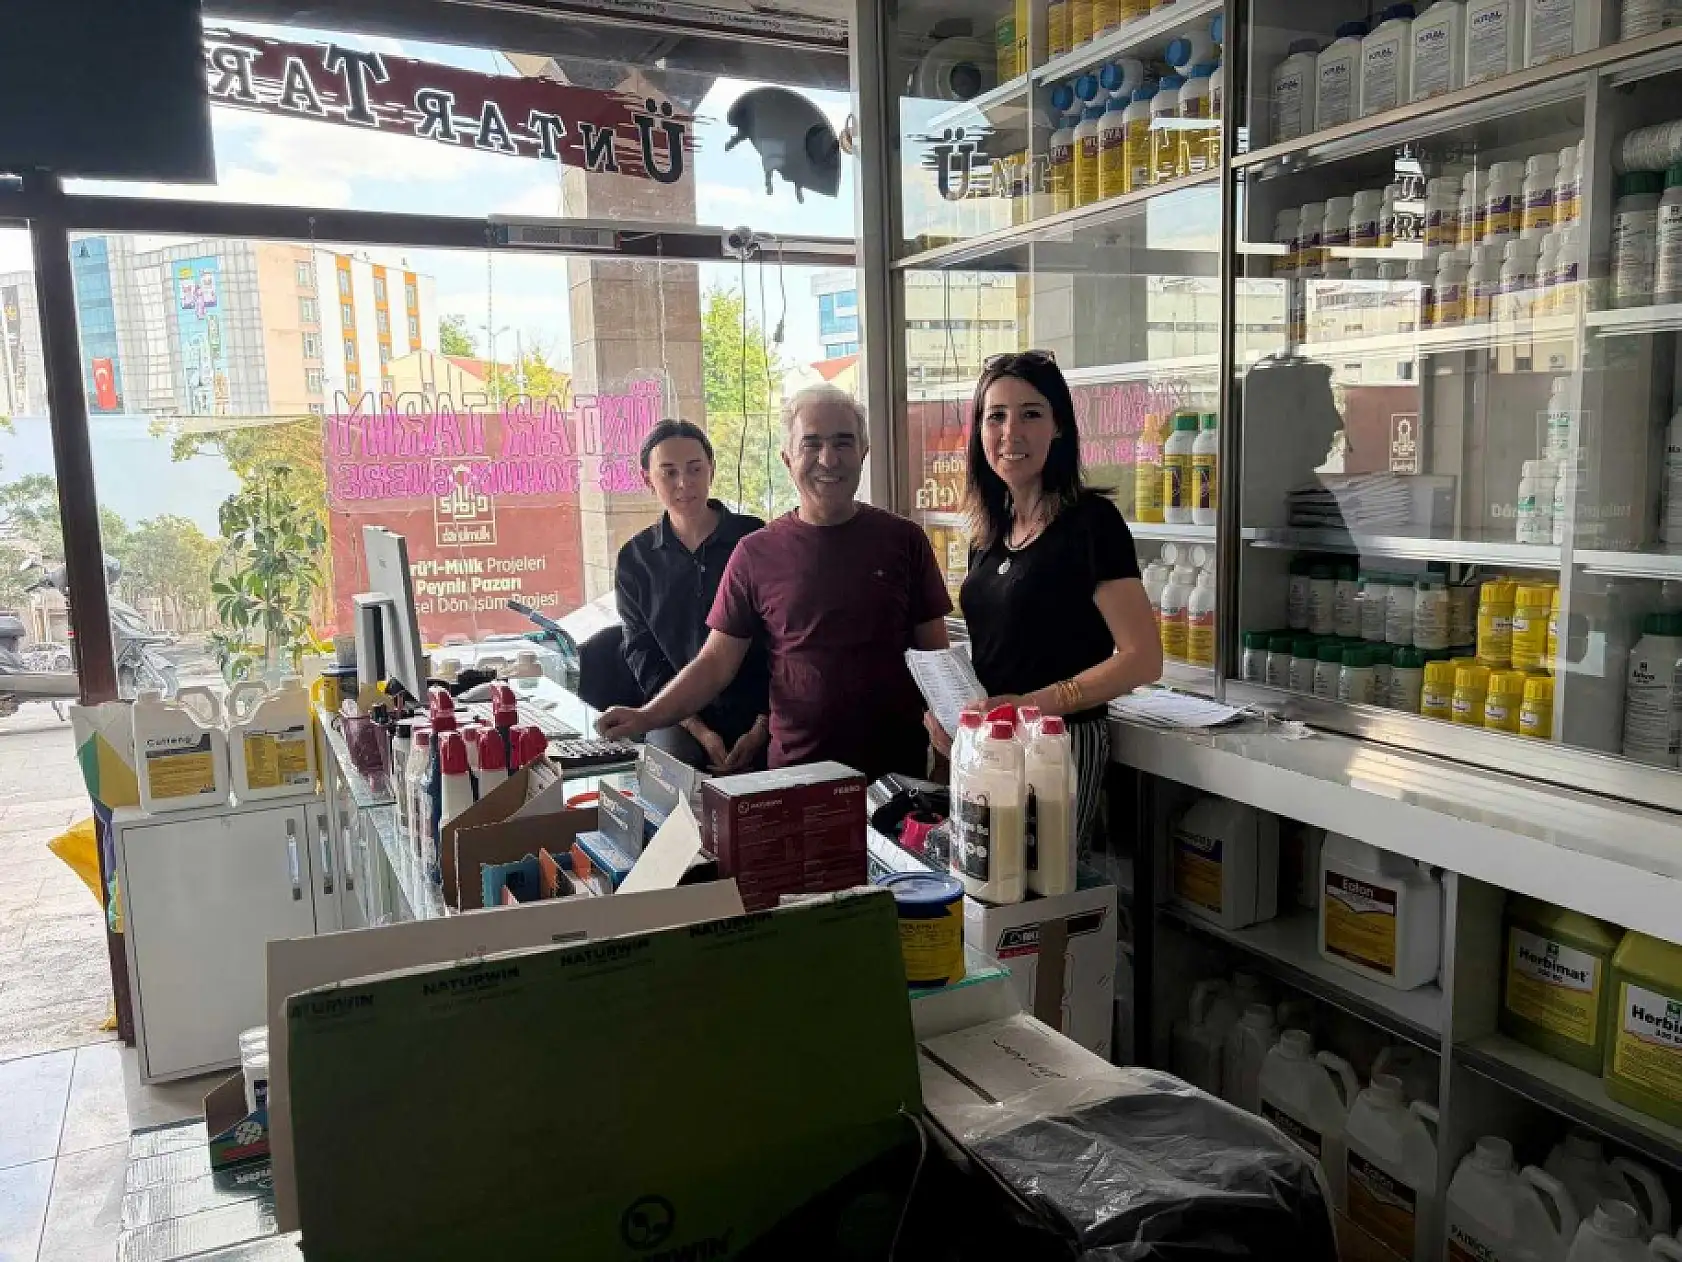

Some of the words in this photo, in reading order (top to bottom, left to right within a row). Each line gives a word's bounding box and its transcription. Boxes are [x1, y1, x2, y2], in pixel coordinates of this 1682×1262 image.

[487, 556, 546, 573] Projeleri
[415, 598, 433, 614] sel
[423, 965, 519, 995] NATURWIN
